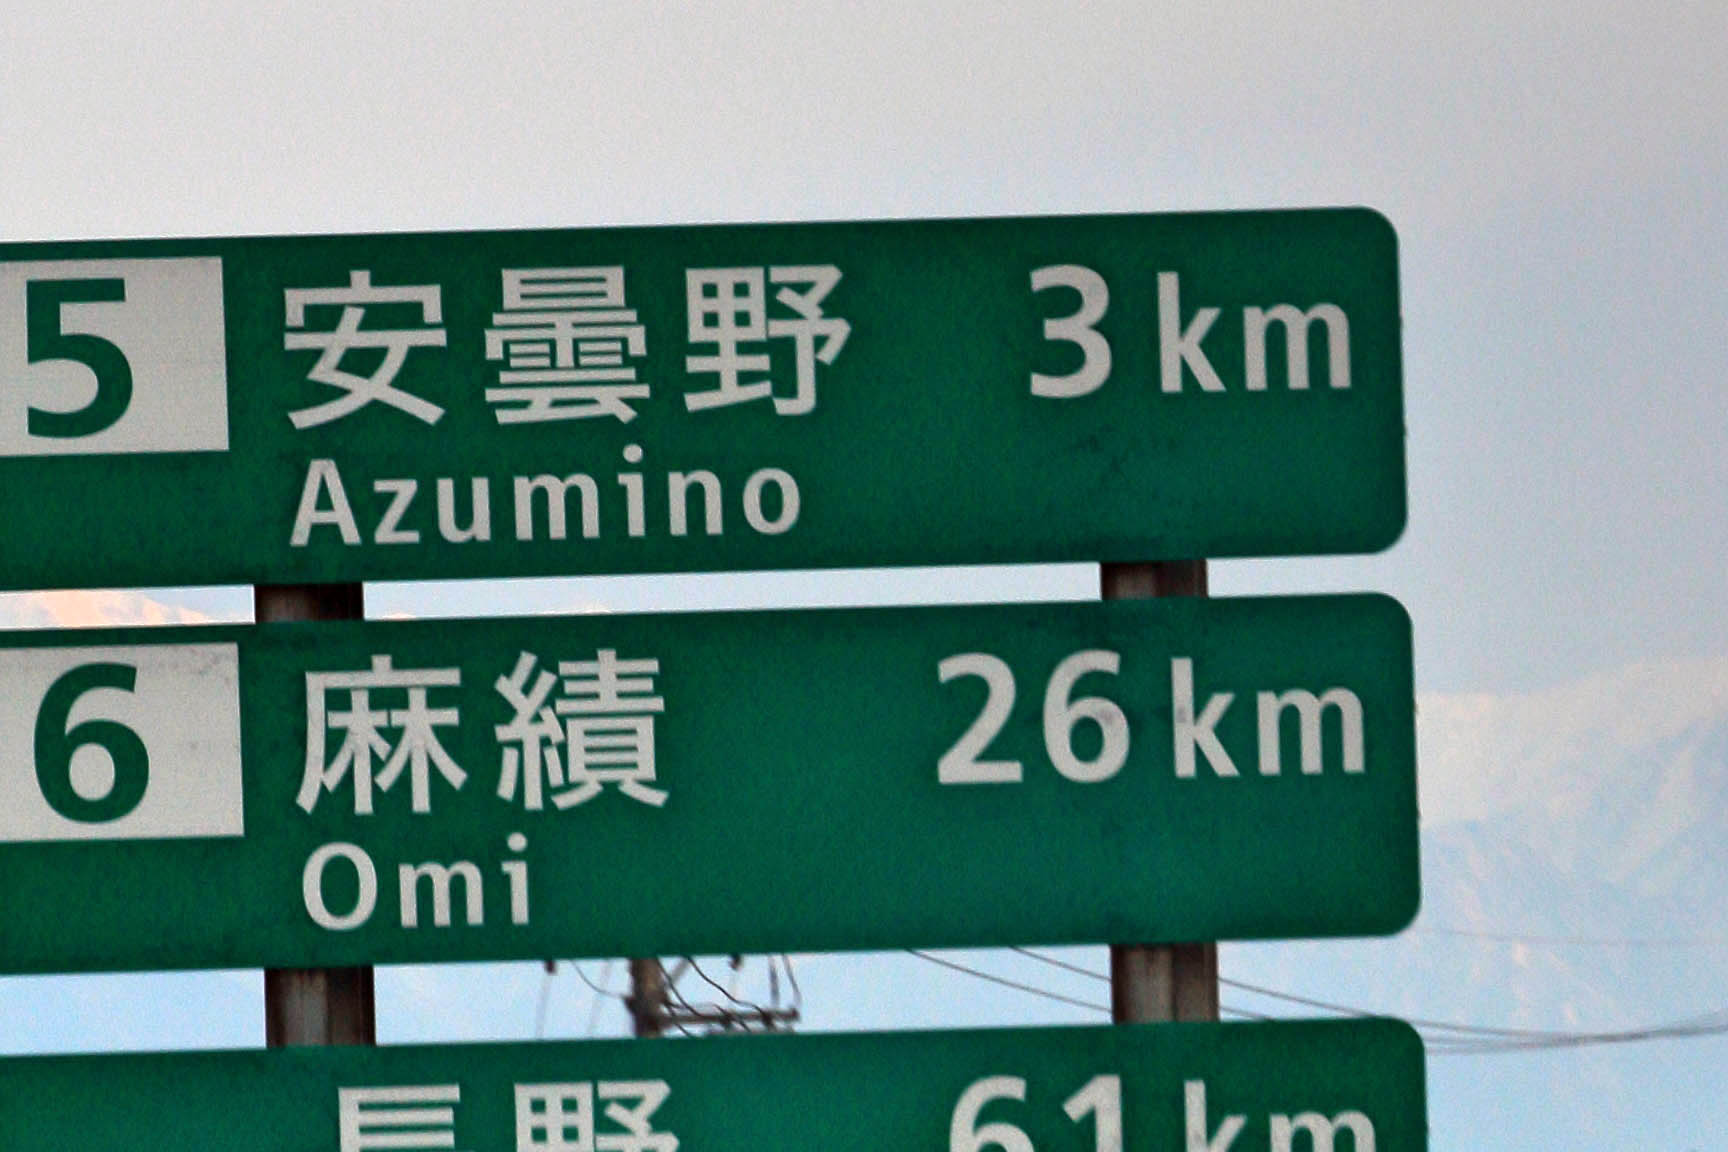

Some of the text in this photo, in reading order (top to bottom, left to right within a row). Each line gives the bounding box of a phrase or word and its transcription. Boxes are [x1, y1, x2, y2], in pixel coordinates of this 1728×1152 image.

[26, 264, 1351, 439] 5 安曇野 3 km
[290, 443, 801, 546] Azumino
[34, 648, 1365, 824] 6 麻績 26 km
[302, 832, 530, 931] Omi
